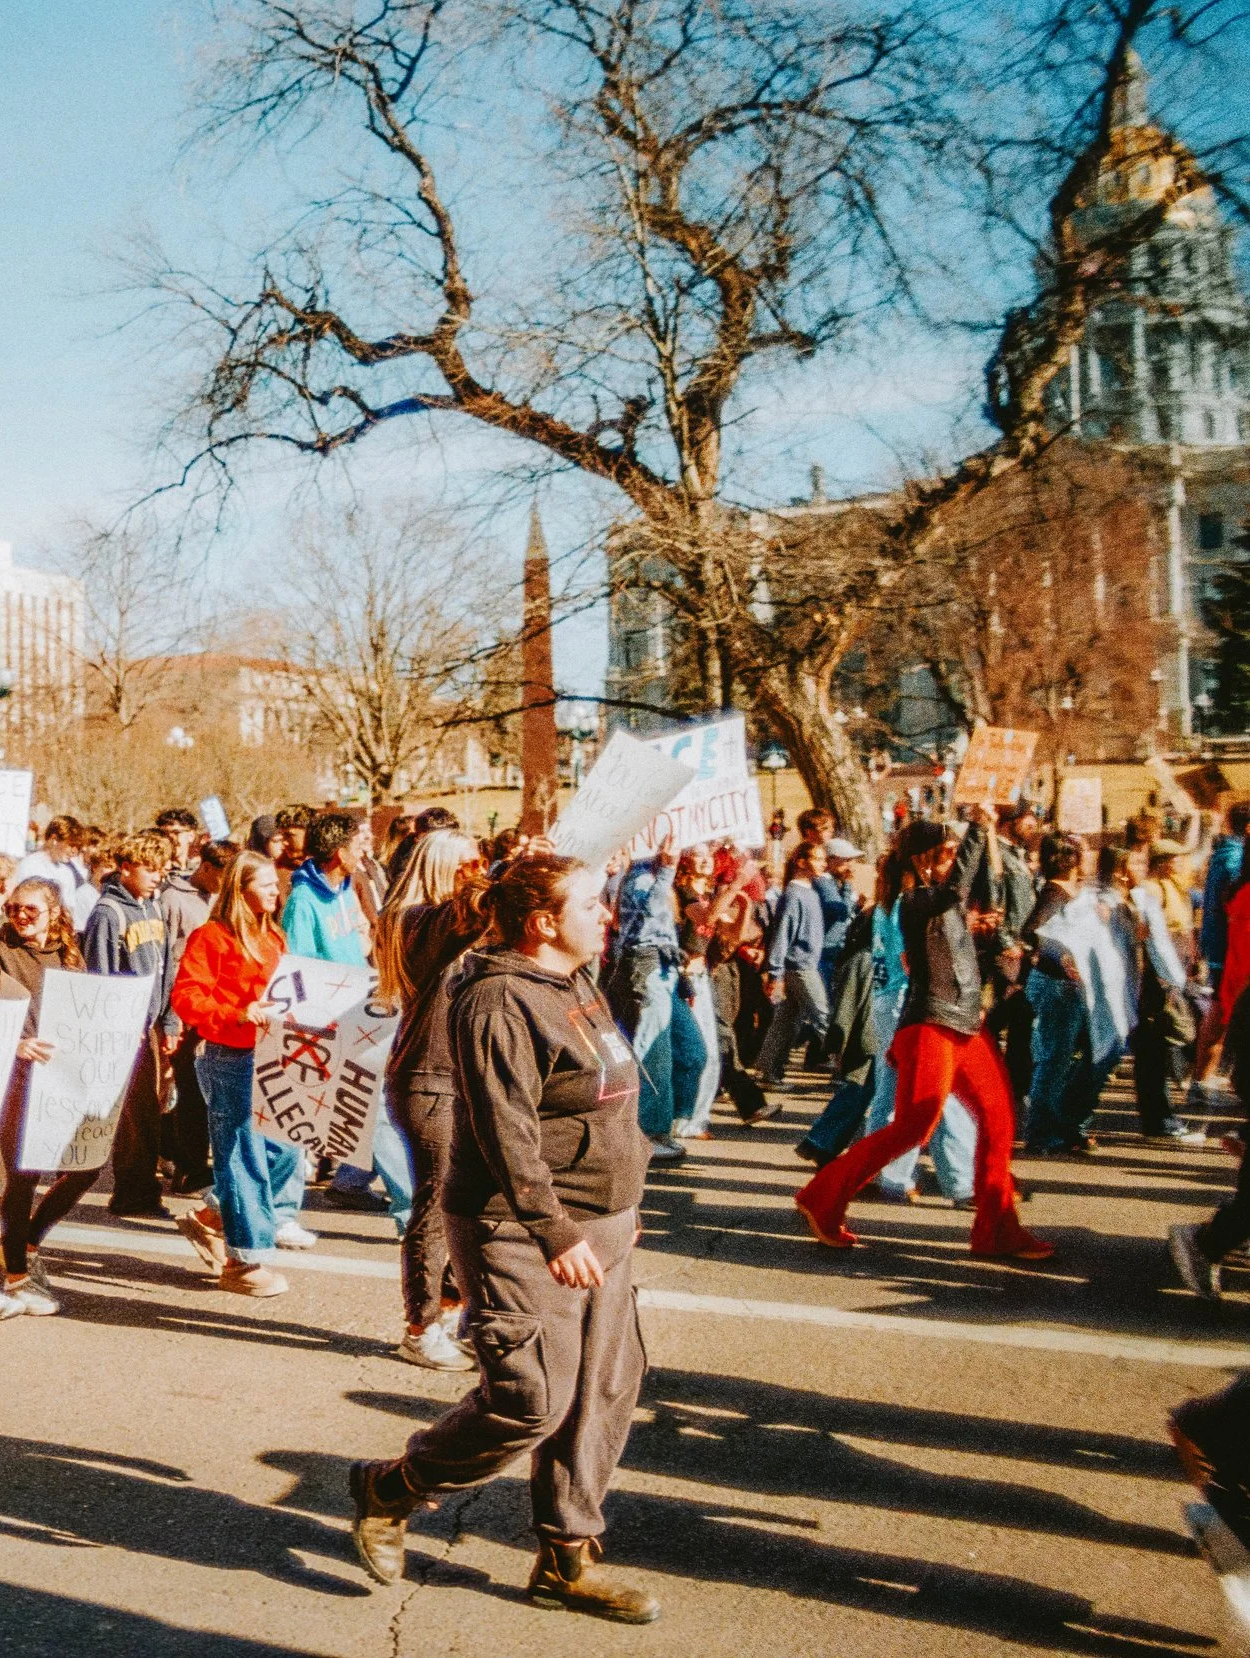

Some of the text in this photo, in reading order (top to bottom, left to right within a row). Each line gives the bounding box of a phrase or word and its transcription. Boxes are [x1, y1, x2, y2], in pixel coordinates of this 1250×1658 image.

[708, 787, 750, 832] CITY
[280, 1019, 338, 1083] ICE
[322, 1058, 377, 1160] HUMAN
